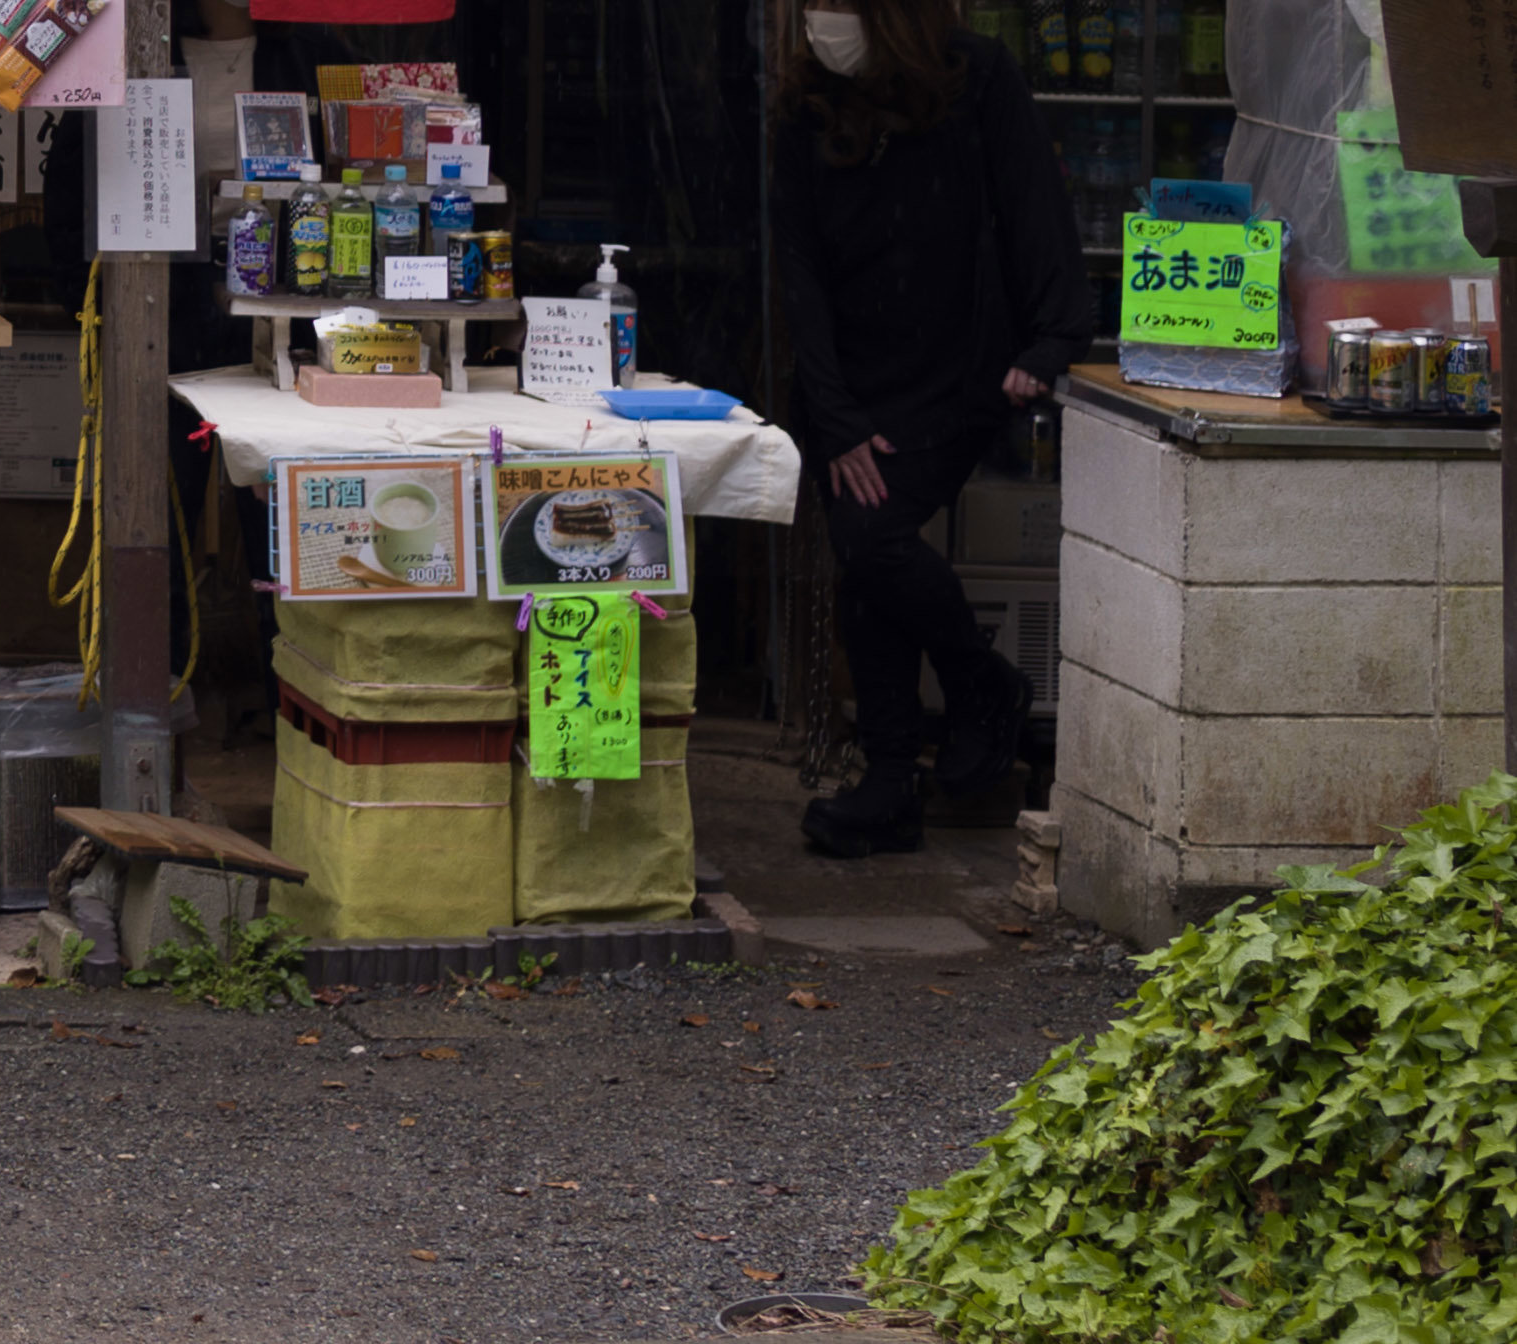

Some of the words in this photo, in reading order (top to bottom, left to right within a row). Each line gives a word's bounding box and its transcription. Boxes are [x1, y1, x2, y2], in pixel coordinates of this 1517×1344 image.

[62, 88, 102, 103] 250円
[175, 128, 186, 172] お客様へ
[110, 214, 123, 236] 店主
[1130, 244, 1246, 291] あま酒
[1233, 327, 1276, 344] 300円
[499, 465, 652, 491] 味噌こんにゃく
[302, 476, 366, 509] 甘酒
[392, 551, 450, 563] ノンアルコール
[406, 565, 453, 584] 300円
[557, 565, 612, 581] 3本入り
[626, 564, 668, 581] 200円
[541, 650, 561, 708] ホット
[574, 649, 593, 709] アイス
